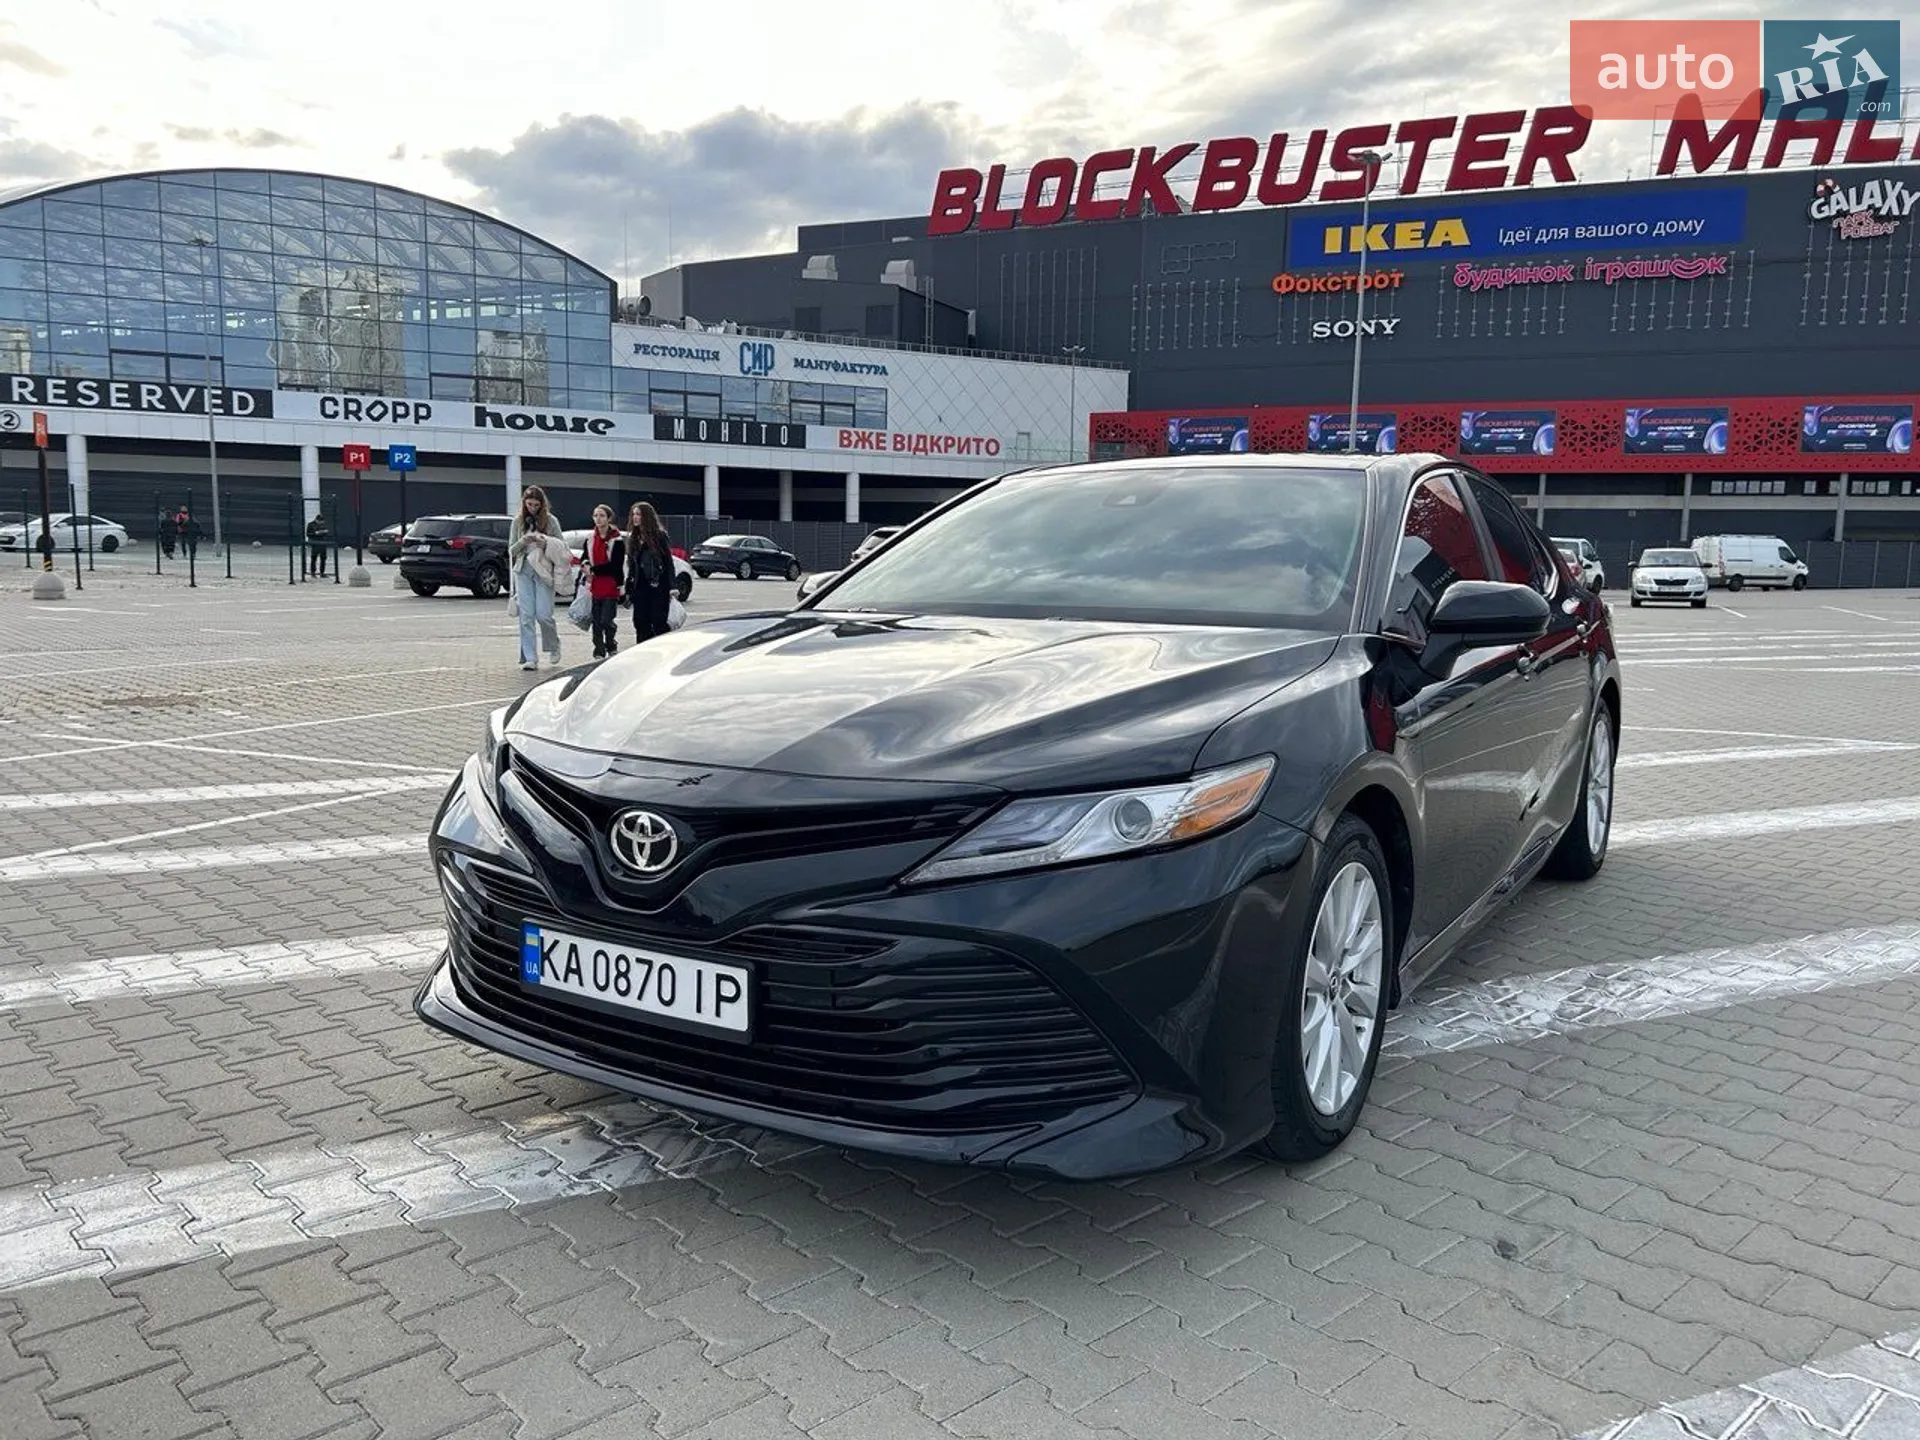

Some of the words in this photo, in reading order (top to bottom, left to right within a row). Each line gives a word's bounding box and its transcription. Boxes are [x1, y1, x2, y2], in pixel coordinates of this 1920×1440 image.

[928, 104, 1594, 236] BLOCKBUSTER
[1656, 80, 1920, 175] MAL
[1811, 179, 1920, 219] GALAXY
[1324, 218, 1471, 254] IKEA
[1499, 226, 1532, 245] Ідеї
[1535, 227, 1569, 244] для
[1575, 222, 1648, 238] вашого
[1653, 218, 1705, 237] дому
[1272, 271, 1404, 294] Фокстрот
[1453, 263, 1575, 291] будинок
[1312, 317, 1402, 338] SONY
[633, 343, 720, 361] РЕСТОРАЦІЯ
[739, 342, 775, 376] СИР
[793, 357, 888, 375] МАНУФАКТУРА
[11, 376, 255, 415] RESERVED
[320, 396, 432, 424] CROPP
[474, 405, 615, 435] house
[838, 429, 887, 451] ВЖЕ
[892, 433, 1000, 457] ВІДКРИТО
[350, 453, 365, 463] P1
[394, 453, 411, 463] P2
[525, 961, 539, 976] UA
[540, 936, 584, 987] KA
[593, 949, 676, 1007] 0870
[695, 969, 741, 1018] IP
